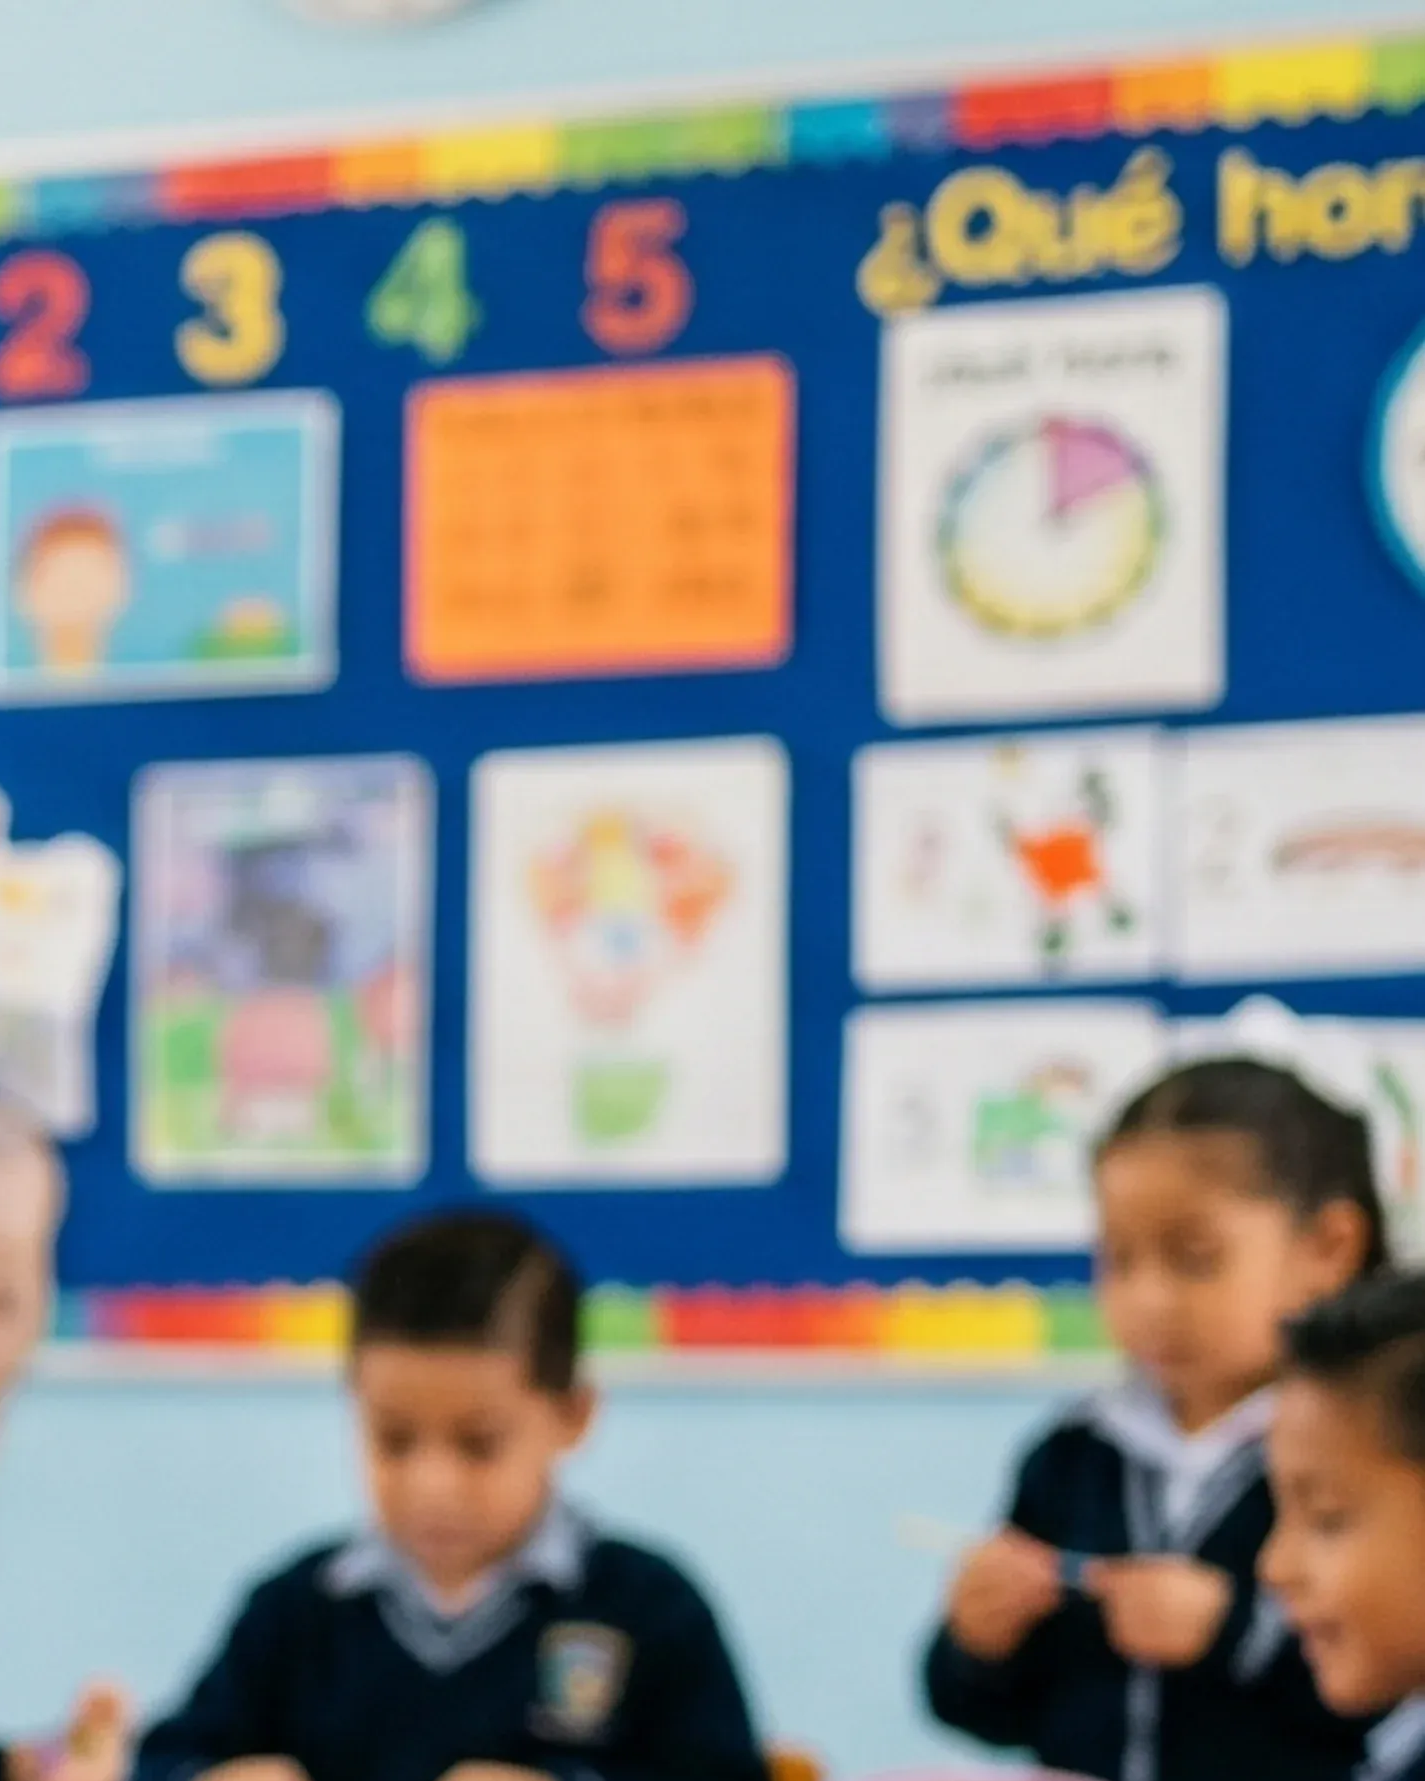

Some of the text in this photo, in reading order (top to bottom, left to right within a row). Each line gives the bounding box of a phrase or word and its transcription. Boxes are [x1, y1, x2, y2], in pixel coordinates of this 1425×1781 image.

[174, 230, 285, 386] 3
[368, 216, 482, 365] 4
[582, 198, 695, 356] 5
[856, 147, 1180, 318] ¿Qué
